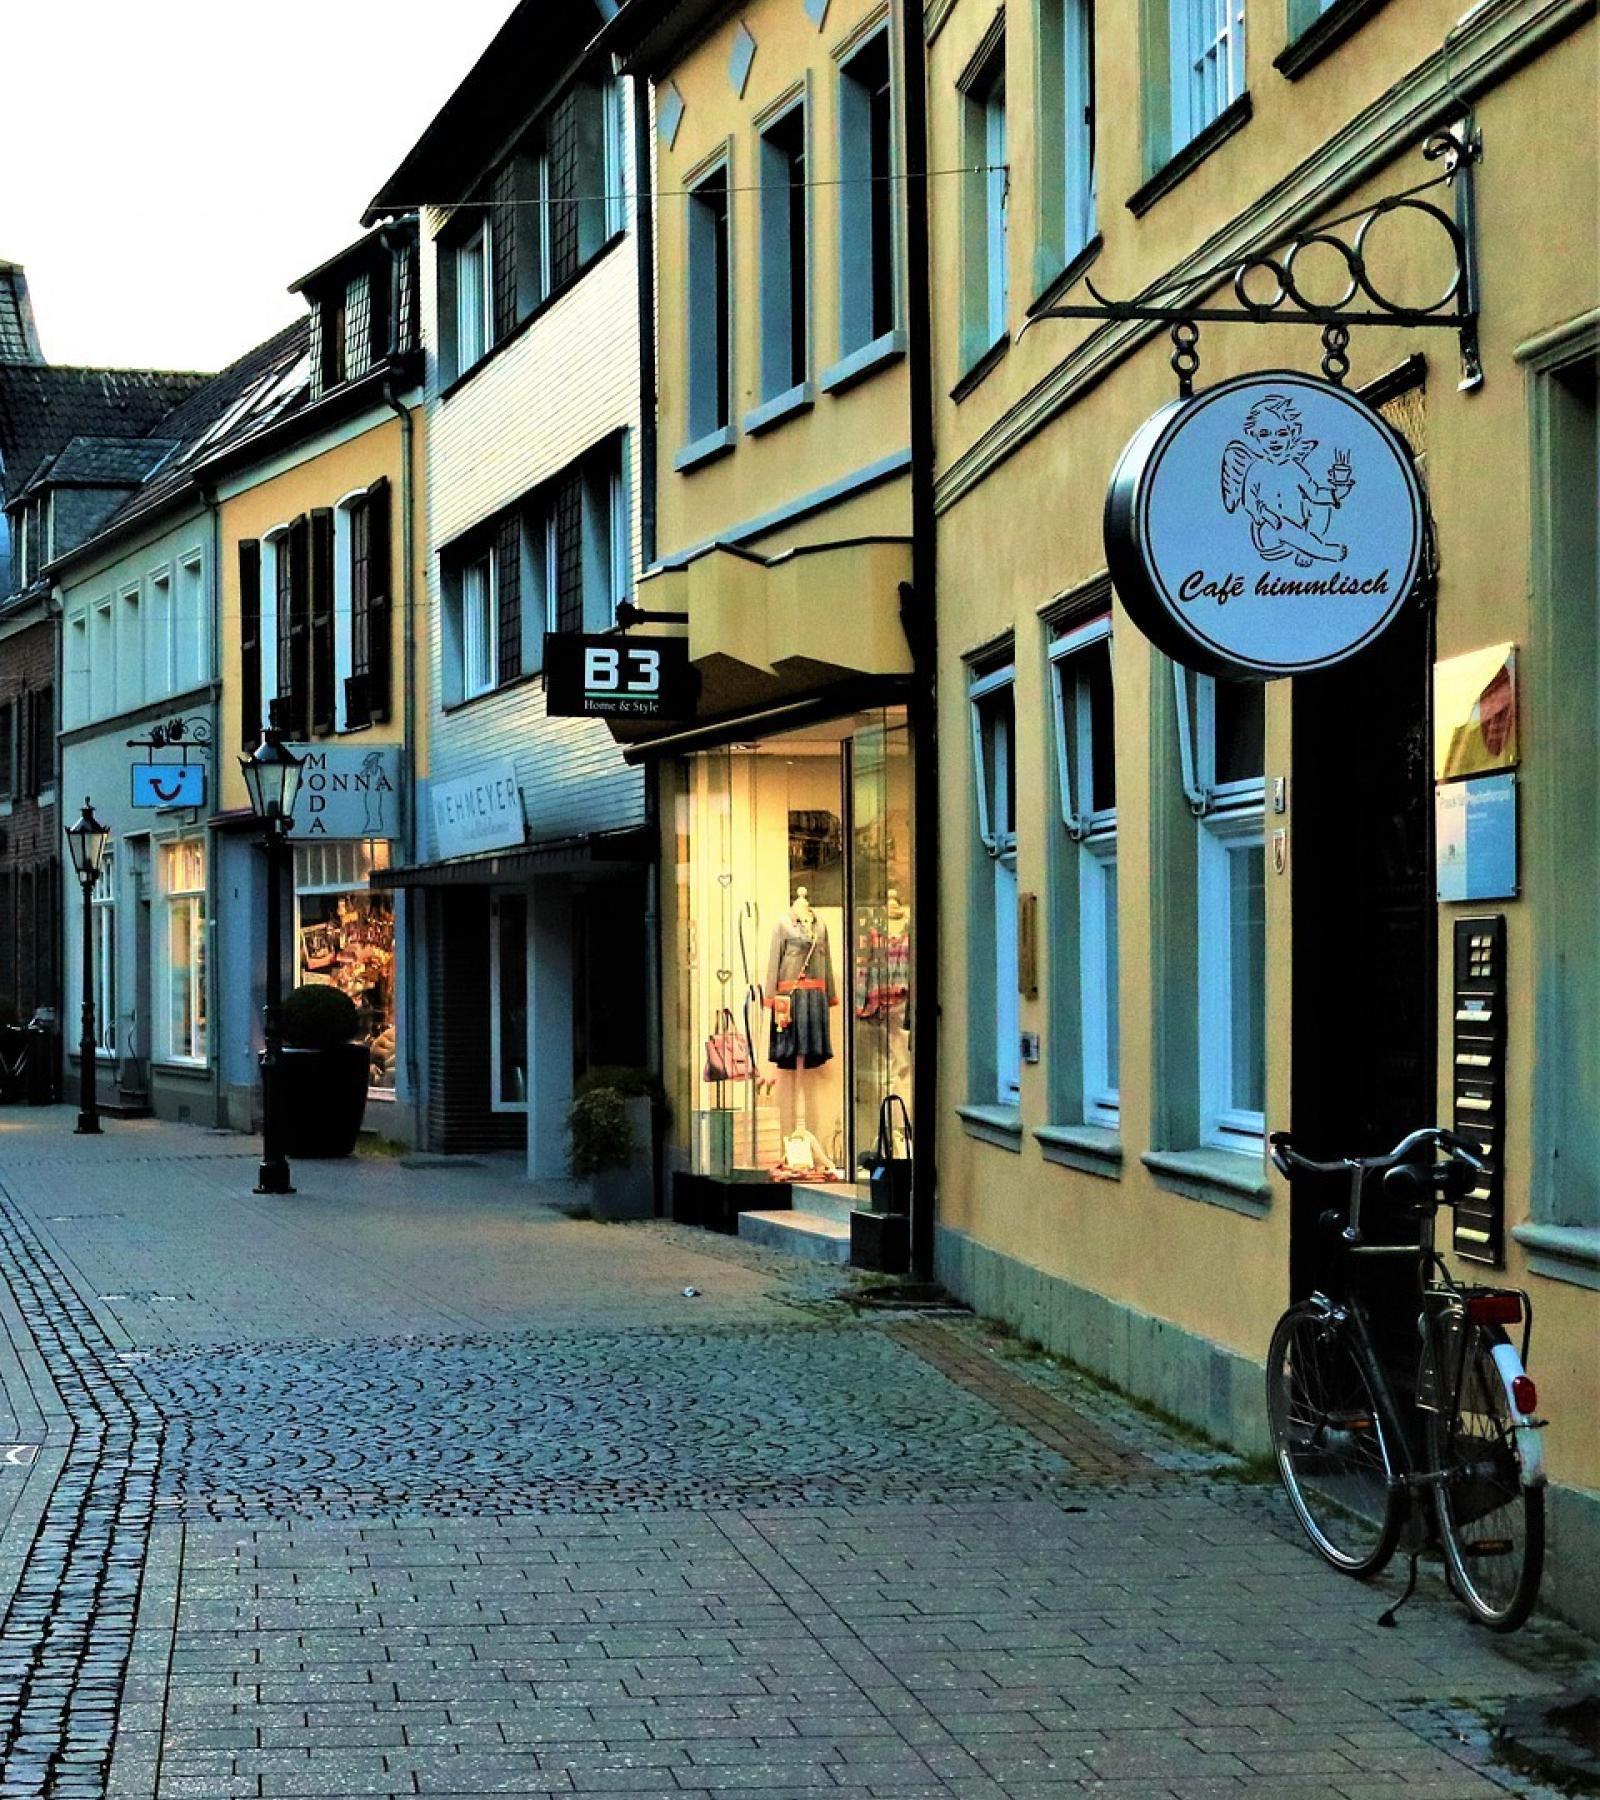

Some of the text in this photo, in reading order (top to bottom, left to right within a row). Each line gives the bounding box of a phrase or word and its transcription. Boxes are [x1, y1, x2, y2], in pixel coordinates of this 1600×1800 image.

[1179, 569, 1390, 606] Café himmlisch
[584, 648, 660, 692] B3
[584, 700, 659, 714] Home & Style
[298, 773, 393, 792] ONNA
